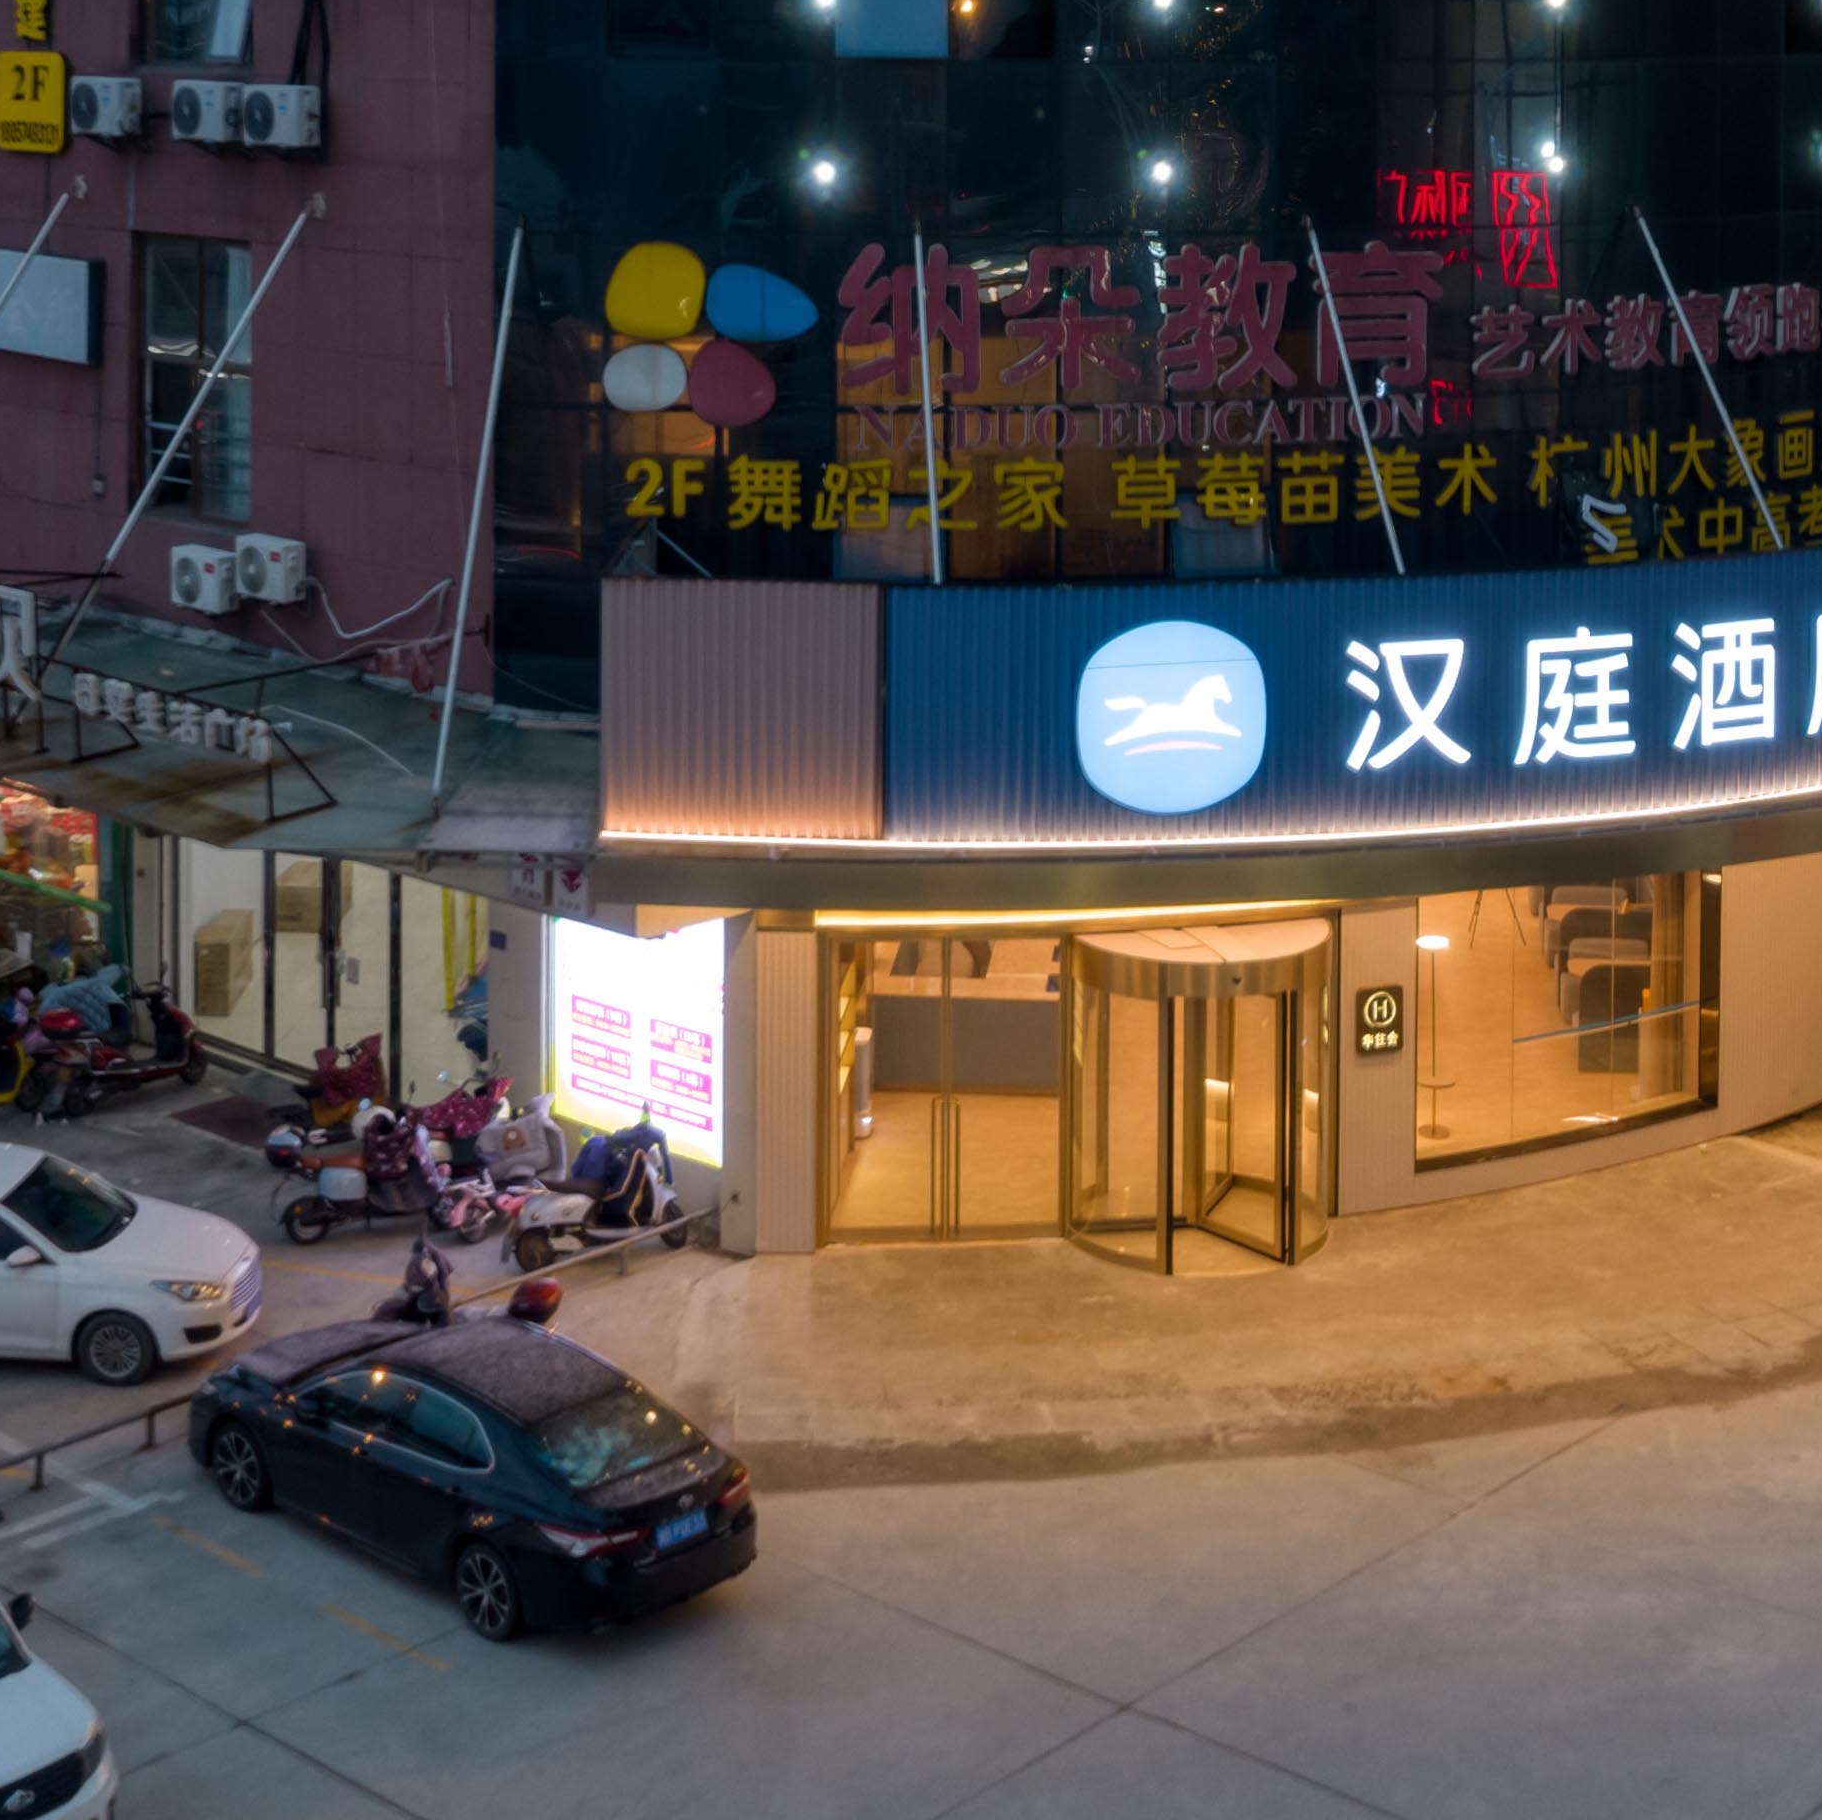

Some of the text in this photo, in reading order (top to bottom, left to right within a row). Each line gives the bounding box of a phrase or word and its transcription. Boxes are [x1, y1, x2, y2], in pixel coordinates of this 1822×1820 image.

[10, 63, 50, 101] 2F
[836, 242, 1447, 395] 纳朵教育
[853, 403, 1078, 451] NADUO
[1096, 392, 1428, 449] EDUCATION
[625, 459, 707, 518] 2F
[728, 455, 1068, 532] 舞蹈之家
[1109, 442, 1499, 530] 草莓苗美术
